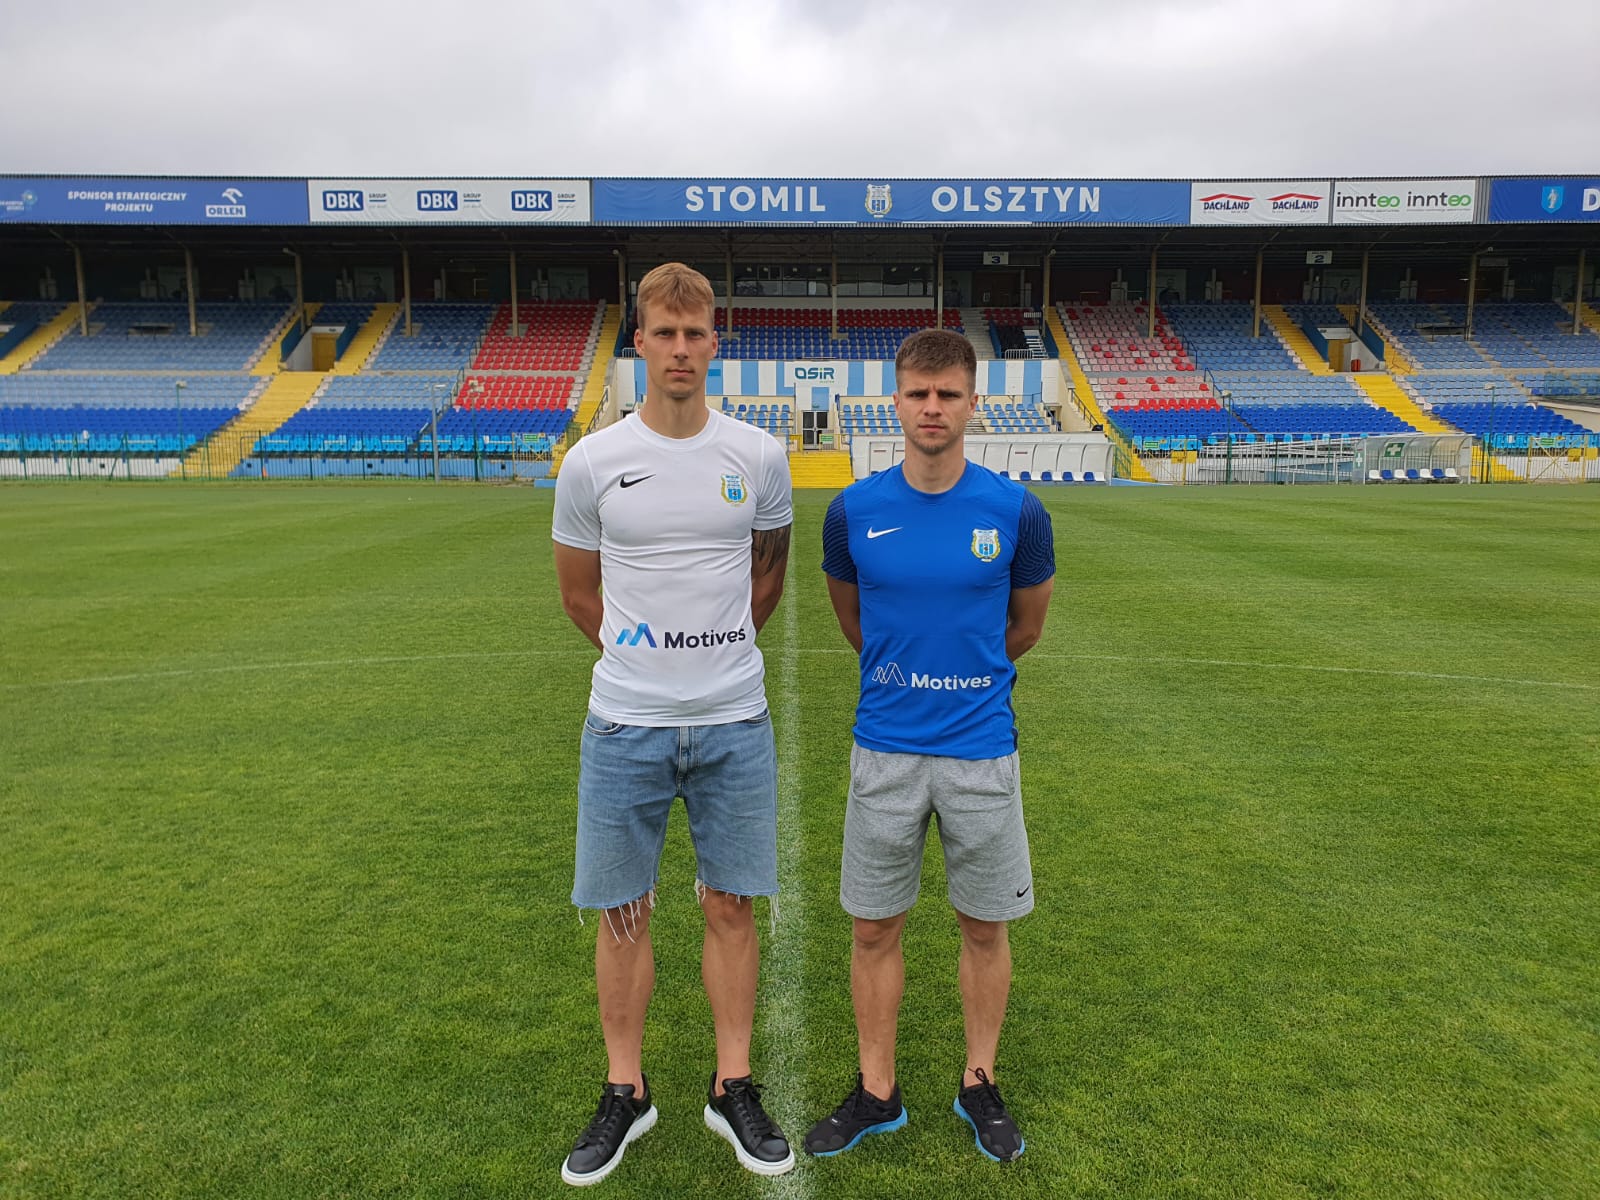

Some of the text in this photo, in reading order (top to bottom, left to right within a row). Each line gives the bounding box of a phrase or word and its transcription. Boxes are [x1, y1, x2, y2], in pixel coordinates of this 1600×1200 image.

[67, 191, 187, 201] SPONSOR STRATEGICZNY
[326, 192, 361, 209] DBK
[420, 192, 455, 209] DBK
[514, 192, 549, 209] DBK
[685, 185, 1100, 213] STOMIL OLSZTYN
[104, 203, 153, 212] PROJEKTU
[208, 206, 244, 216] ORLEN
[992, 256, 1000, 264] 3
[1315, 255, 1324, 263] 2
[664, 628, 746, 649] Motives
[911, 672, 992, 690] Motives
